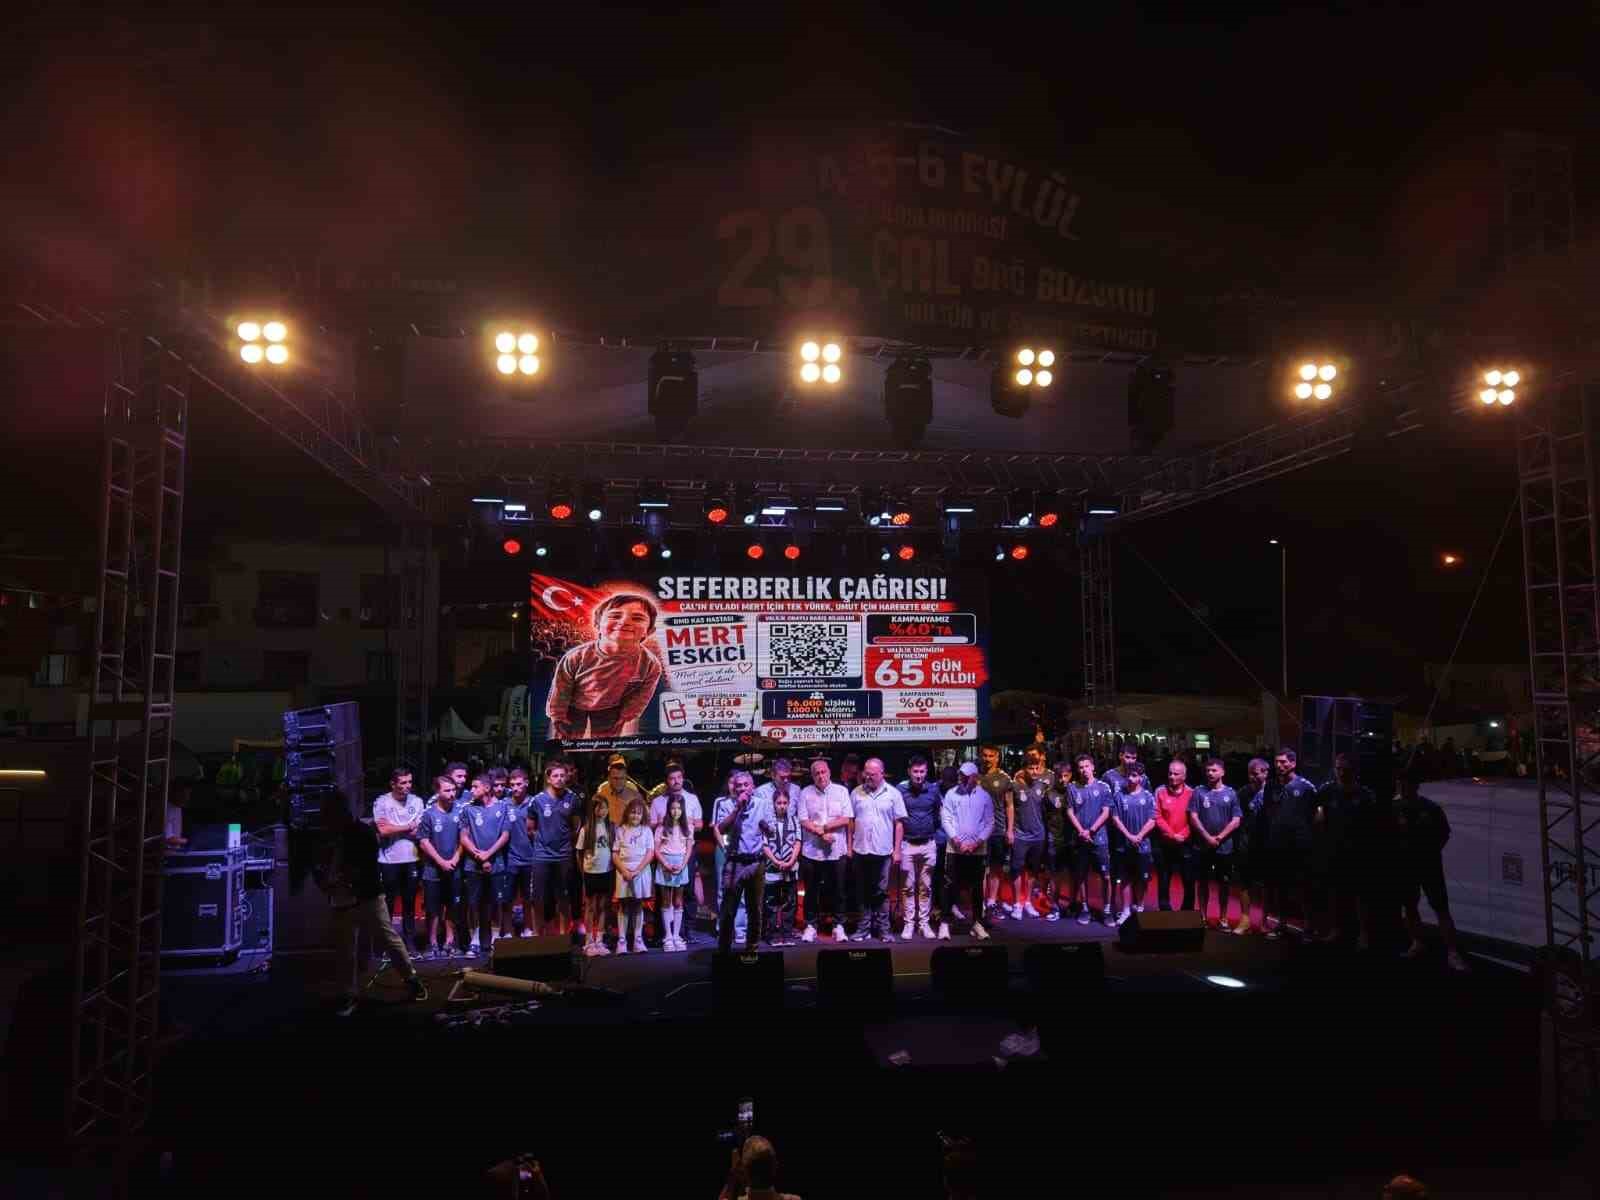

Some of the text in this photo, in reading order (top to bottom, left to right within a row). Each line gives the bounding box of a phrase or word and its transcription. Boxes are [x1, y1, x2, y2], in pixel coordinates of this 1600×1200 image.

[658, 574, 947, 603] SEFERBERLİK ÇAĞRISI!
[891, 615, 950, 624] KAMPANYAMIZ
[665, 624, 748, 649] MERT
[668, 645, 746, 666] ESKİCİ
[931, 658, 961, 672] GÜN
[875, 658, 925, 688] 65
[931, 673, 976, 685] KALDI!
